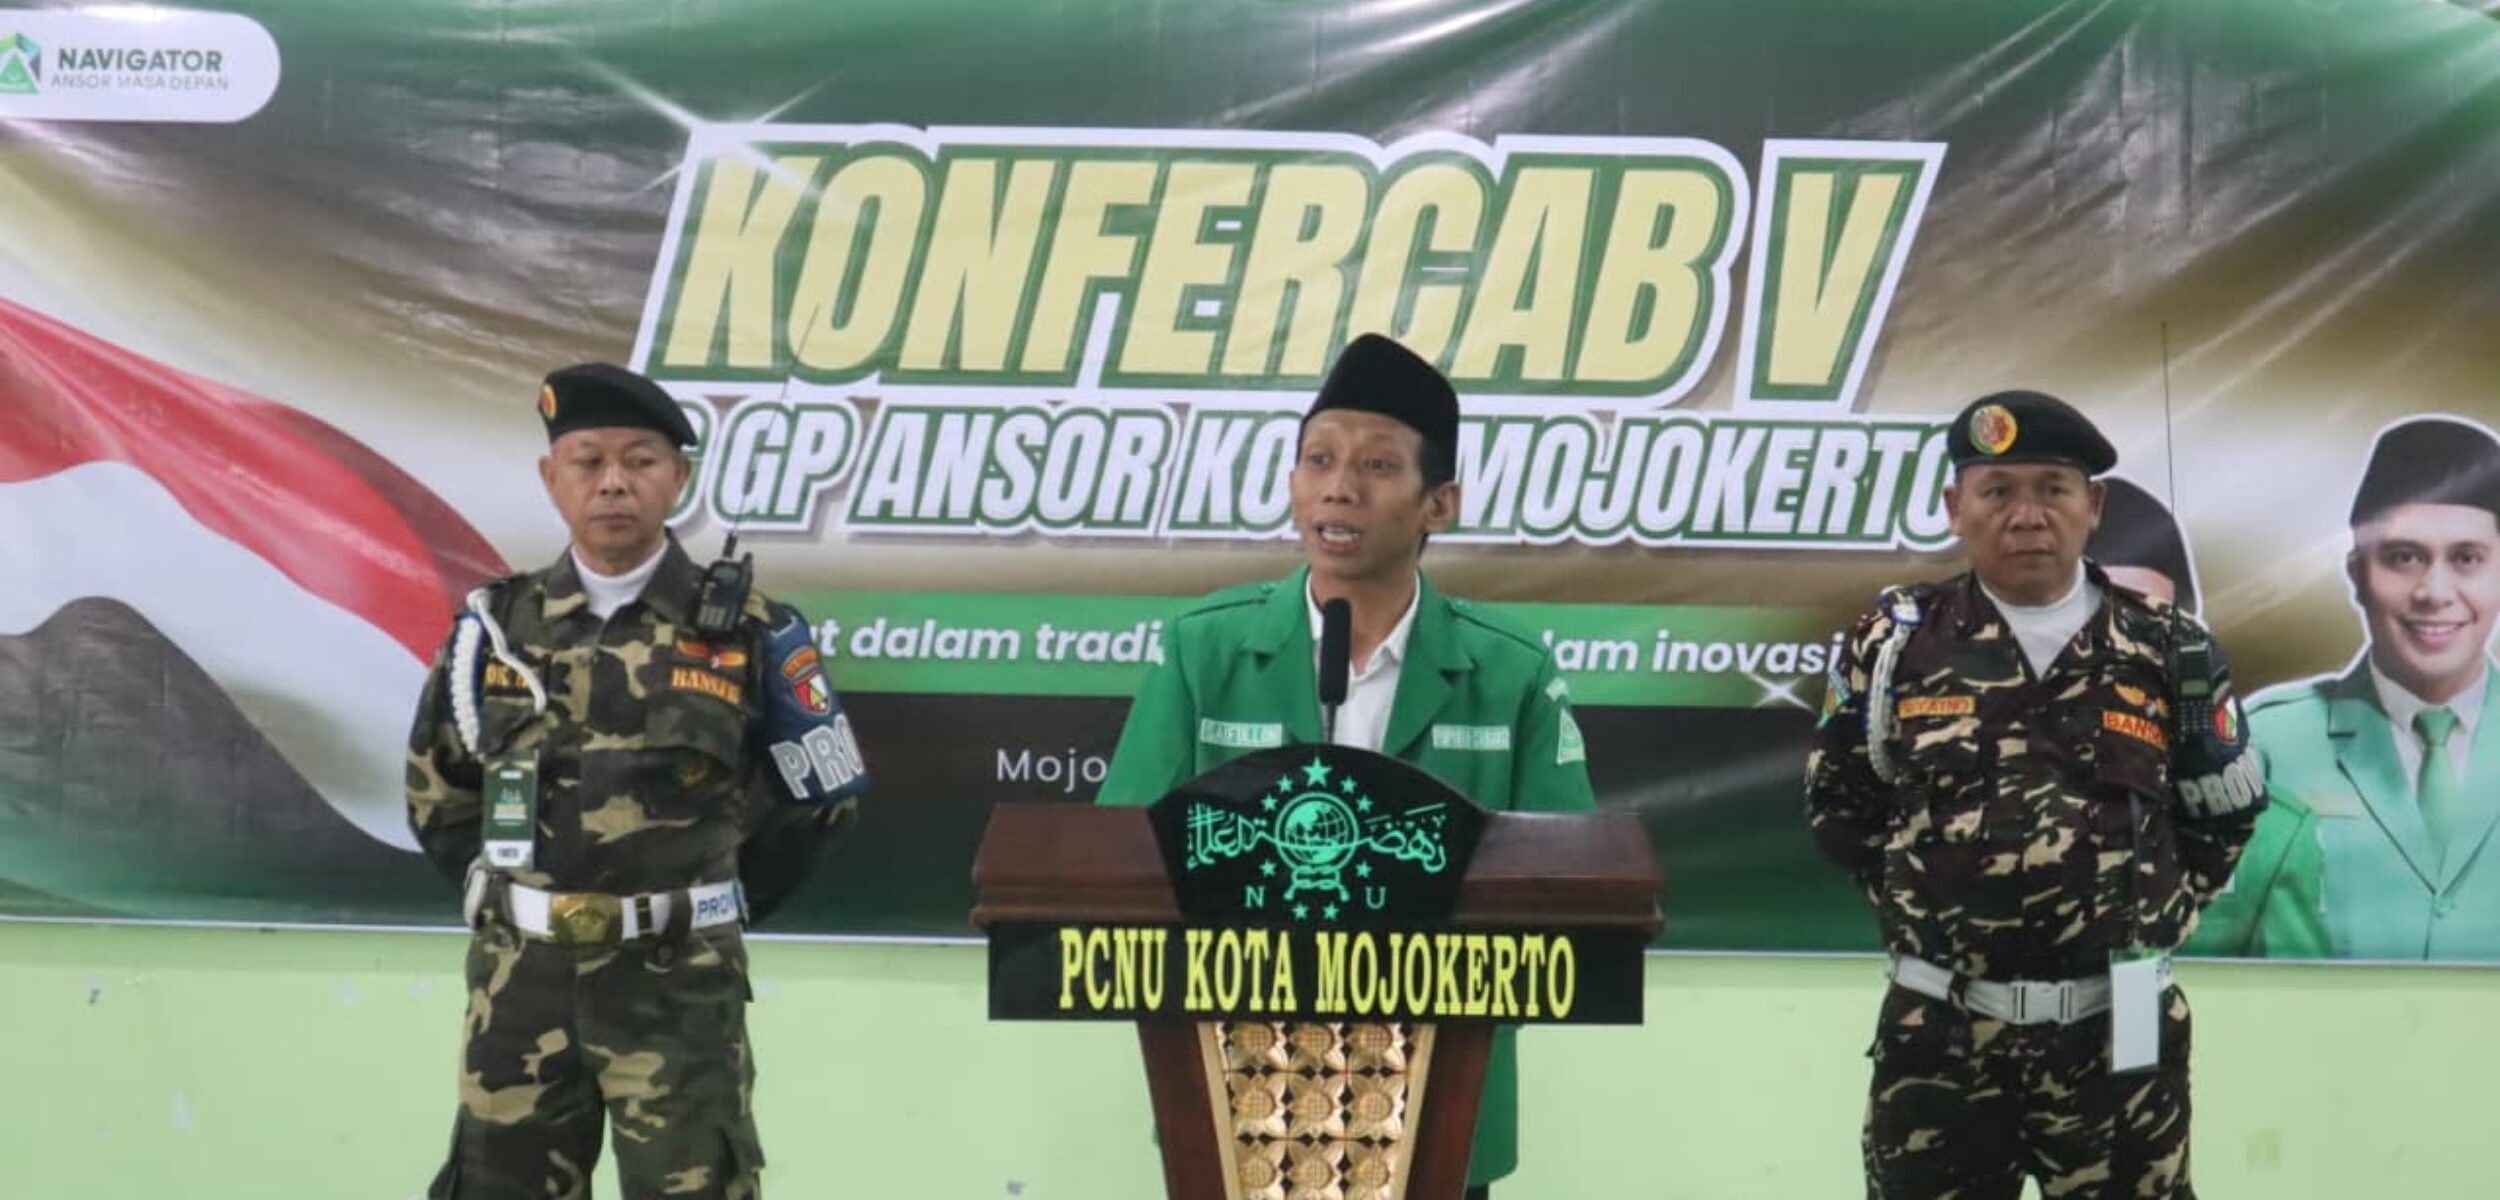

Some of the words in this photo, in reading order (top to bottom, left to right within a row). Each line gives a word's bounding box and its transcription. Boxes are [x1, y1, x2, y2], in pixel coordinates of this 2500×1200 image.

[51, 73, 111, 89] ANSOR
[117, 74, 165, 90] MASA
[169, 75, 229, 91] DEPAN
[58, 47, 223, 72] NAVIGATOR
[663, 154, 1722, 382] KONFERCAB
[1767, 173, 1904, 386] V
[721, 409, 847, 516] GP
[856, 411, 1167, 522] ANSOR
[1459, 421, 1956, 537] MOJOKERTO
[850, 617, 1004, 660] dalam
[1036, 619, 1165, 667] tradi
[1652, 628, 1844, 674] inovasi
[997, 747, 1107, 794] Mojo
[1244, 886, 1266, 908] N
[1364, 886, 1387, 909] U
[1059, 927, 1168, 1011] PCNU
[1184, 928, 1298, 1013] KOTA
[1314, 930, 1577, 1019] MOJOKERTO
